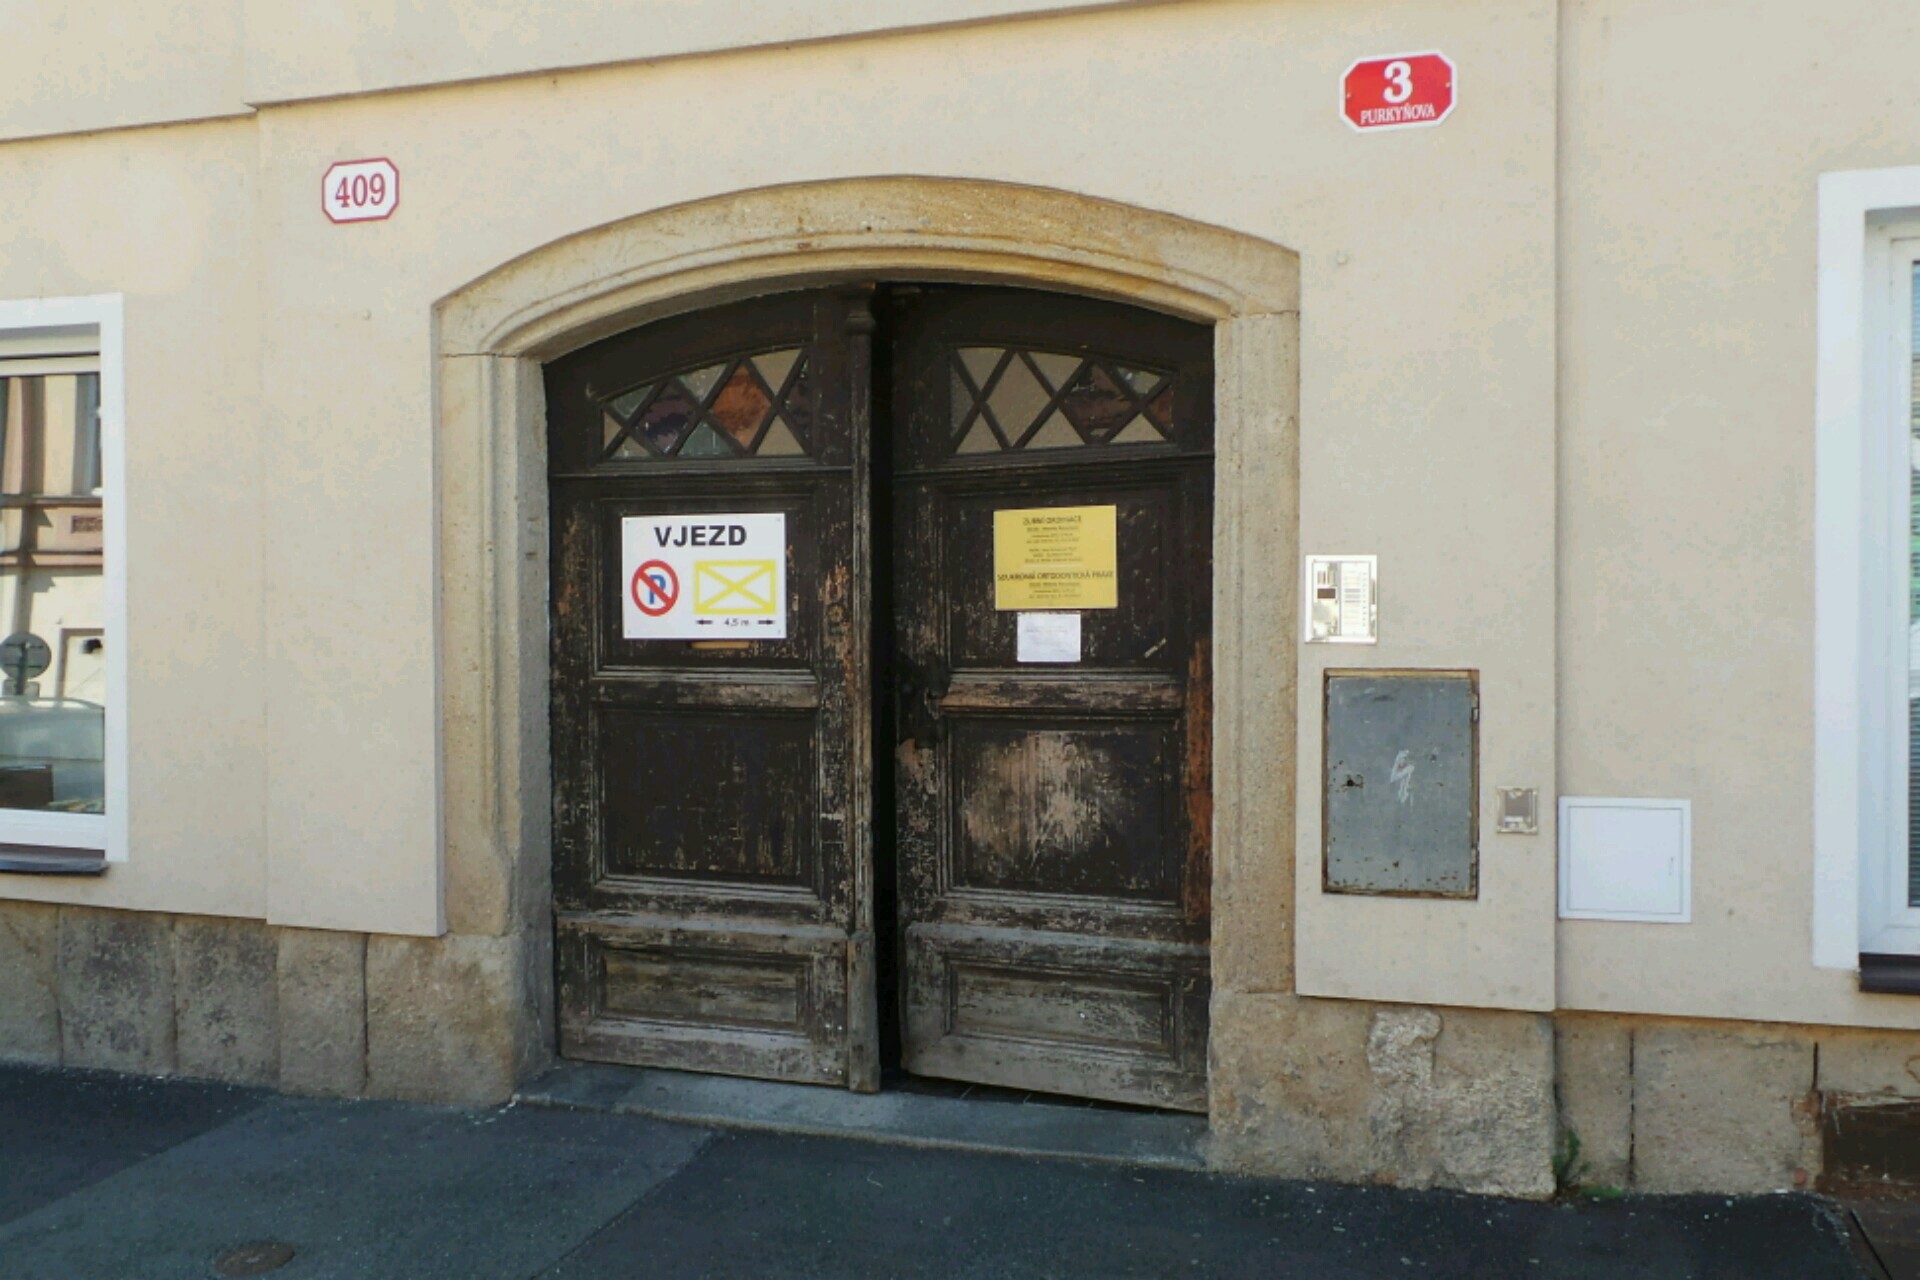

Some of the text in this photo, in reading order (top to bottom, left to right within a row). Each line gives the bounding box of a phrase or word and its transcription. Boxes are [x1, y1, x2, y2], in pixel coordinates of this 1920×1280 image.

[1383, 60, 1413, 103] 3
[1360, 103, 1436, 125] PURKYŇOVA
[335, 172, 386, 208] 409
[654, 525, 747, 547] VJEZD
